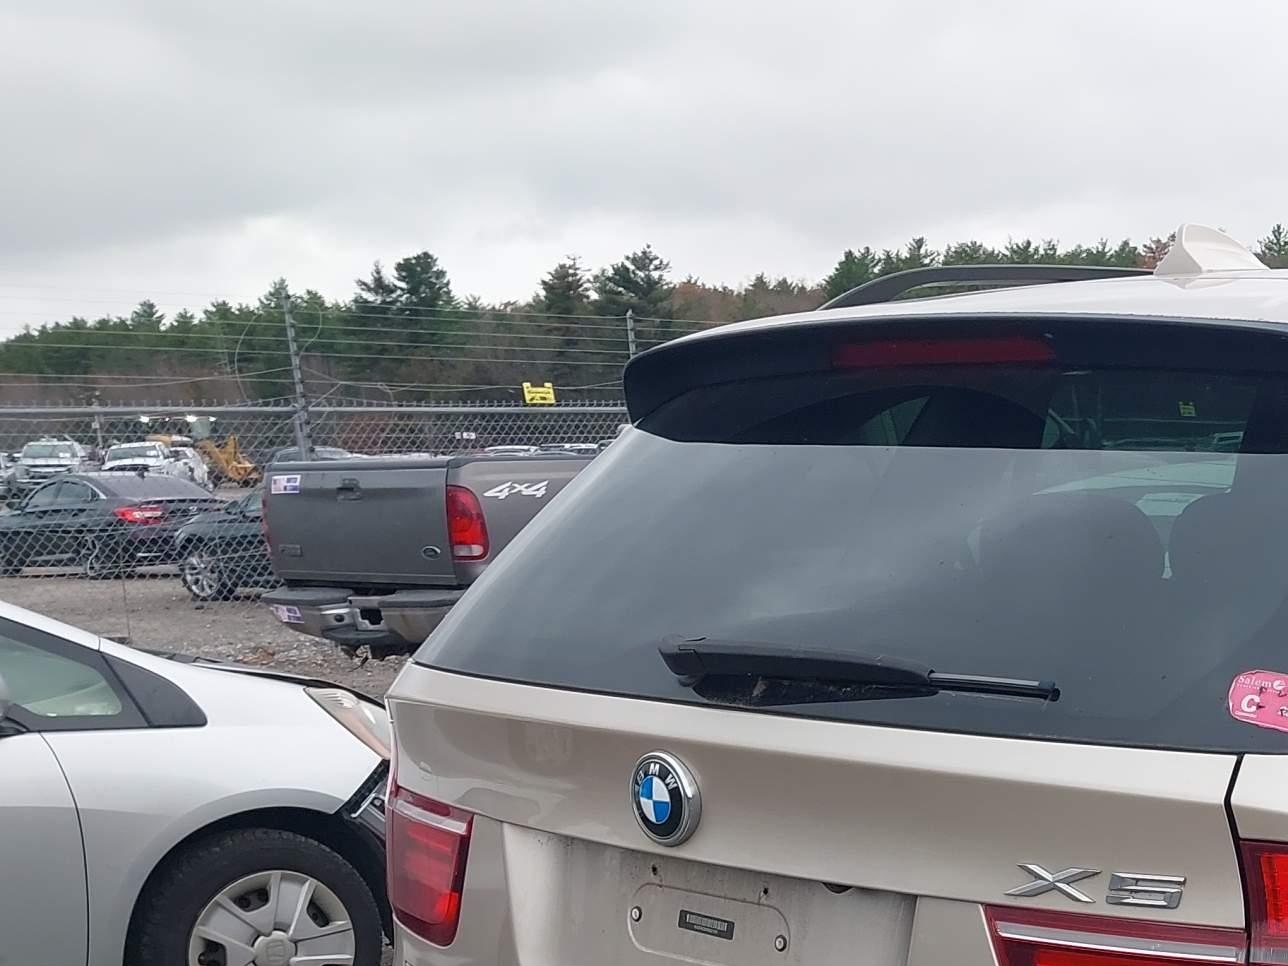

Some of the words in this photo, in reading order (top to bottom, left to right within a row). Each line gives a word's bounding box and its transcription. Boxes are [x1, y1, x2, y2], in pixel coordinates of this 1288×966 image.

[1238, 675, 1272, 689] Salem
[1241, 694, 1260, 713] C
[635, 762, 678, 791] BMW
[1003, 863, 1187, 910] X5
